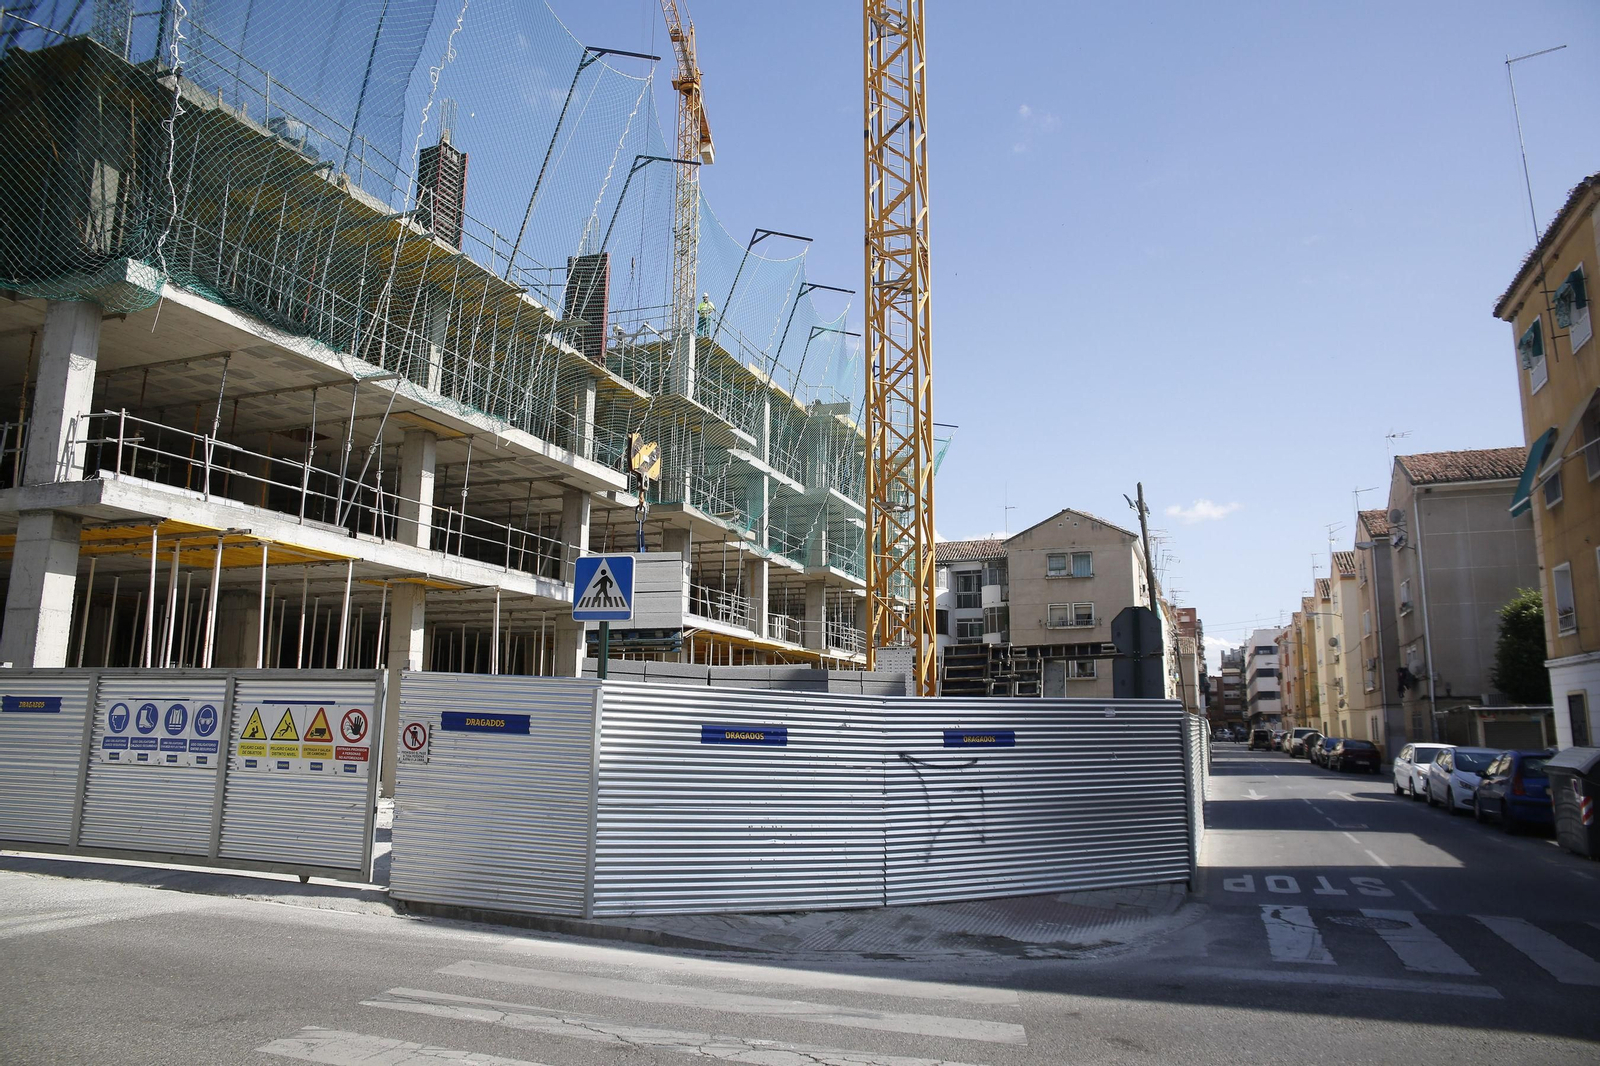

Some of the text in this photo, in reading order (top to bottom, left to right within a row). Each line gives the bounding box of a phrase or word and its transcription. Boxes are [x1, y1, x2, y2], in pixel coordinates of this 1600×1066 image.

[465, 718, 506, 727] DRAGADOS
[725, 732, 765, 740] DRAGADOS
[963, 735, 996, 743] DRAGADOS
[1223, 874, 1395, 897] STOP
